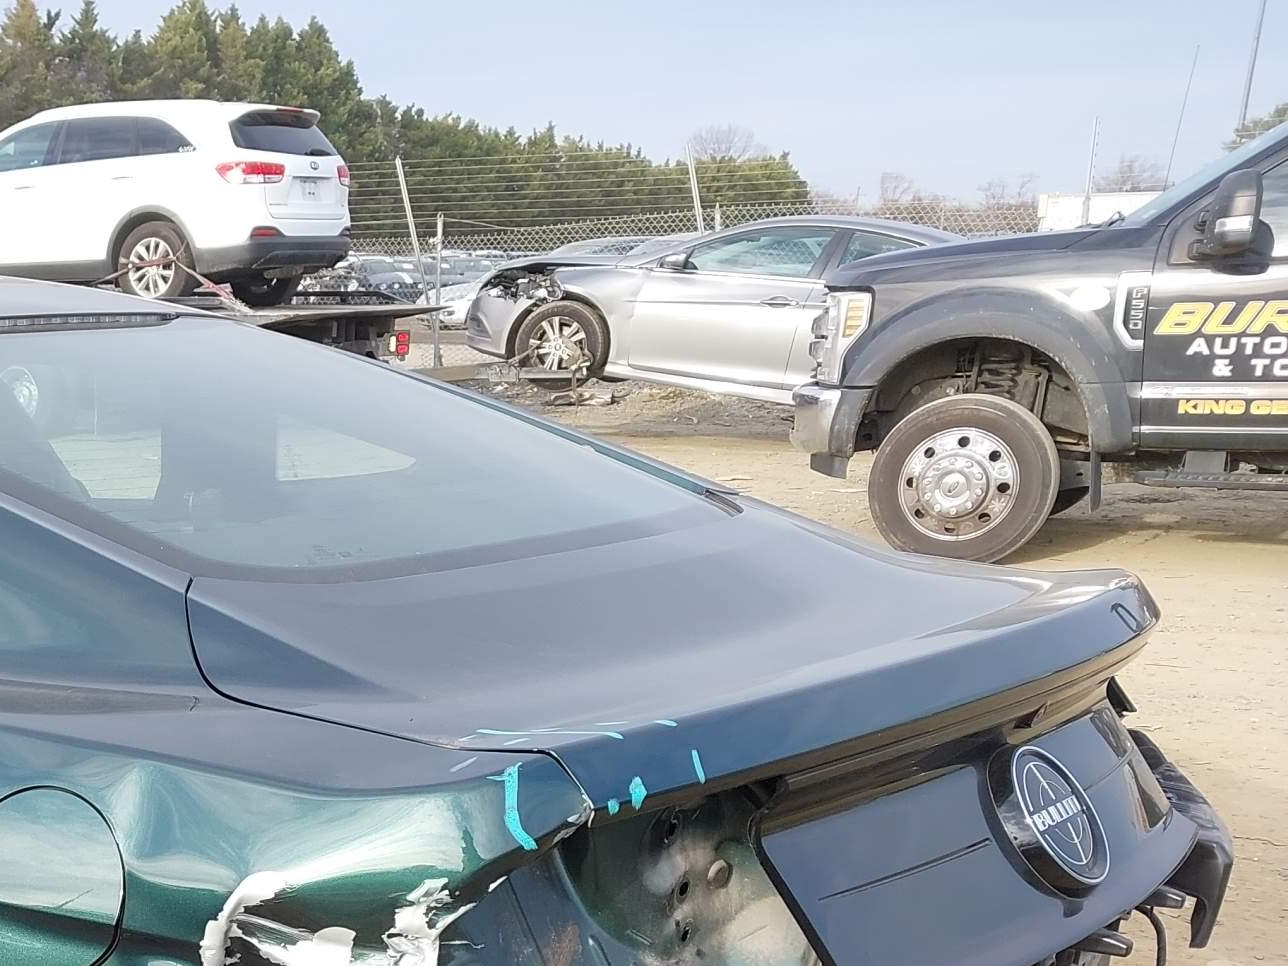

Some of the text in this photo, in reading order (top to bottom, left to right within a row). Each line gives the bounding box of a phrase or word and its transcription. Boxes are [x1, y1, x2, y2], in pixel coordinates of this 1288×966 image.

[1153, 300, 1288, 335] BUR
[1185, 336, 1288, 355] AUTO
[1212, 358, 1288, 377] & TO
[1177, 400, 1246, 415] KING
